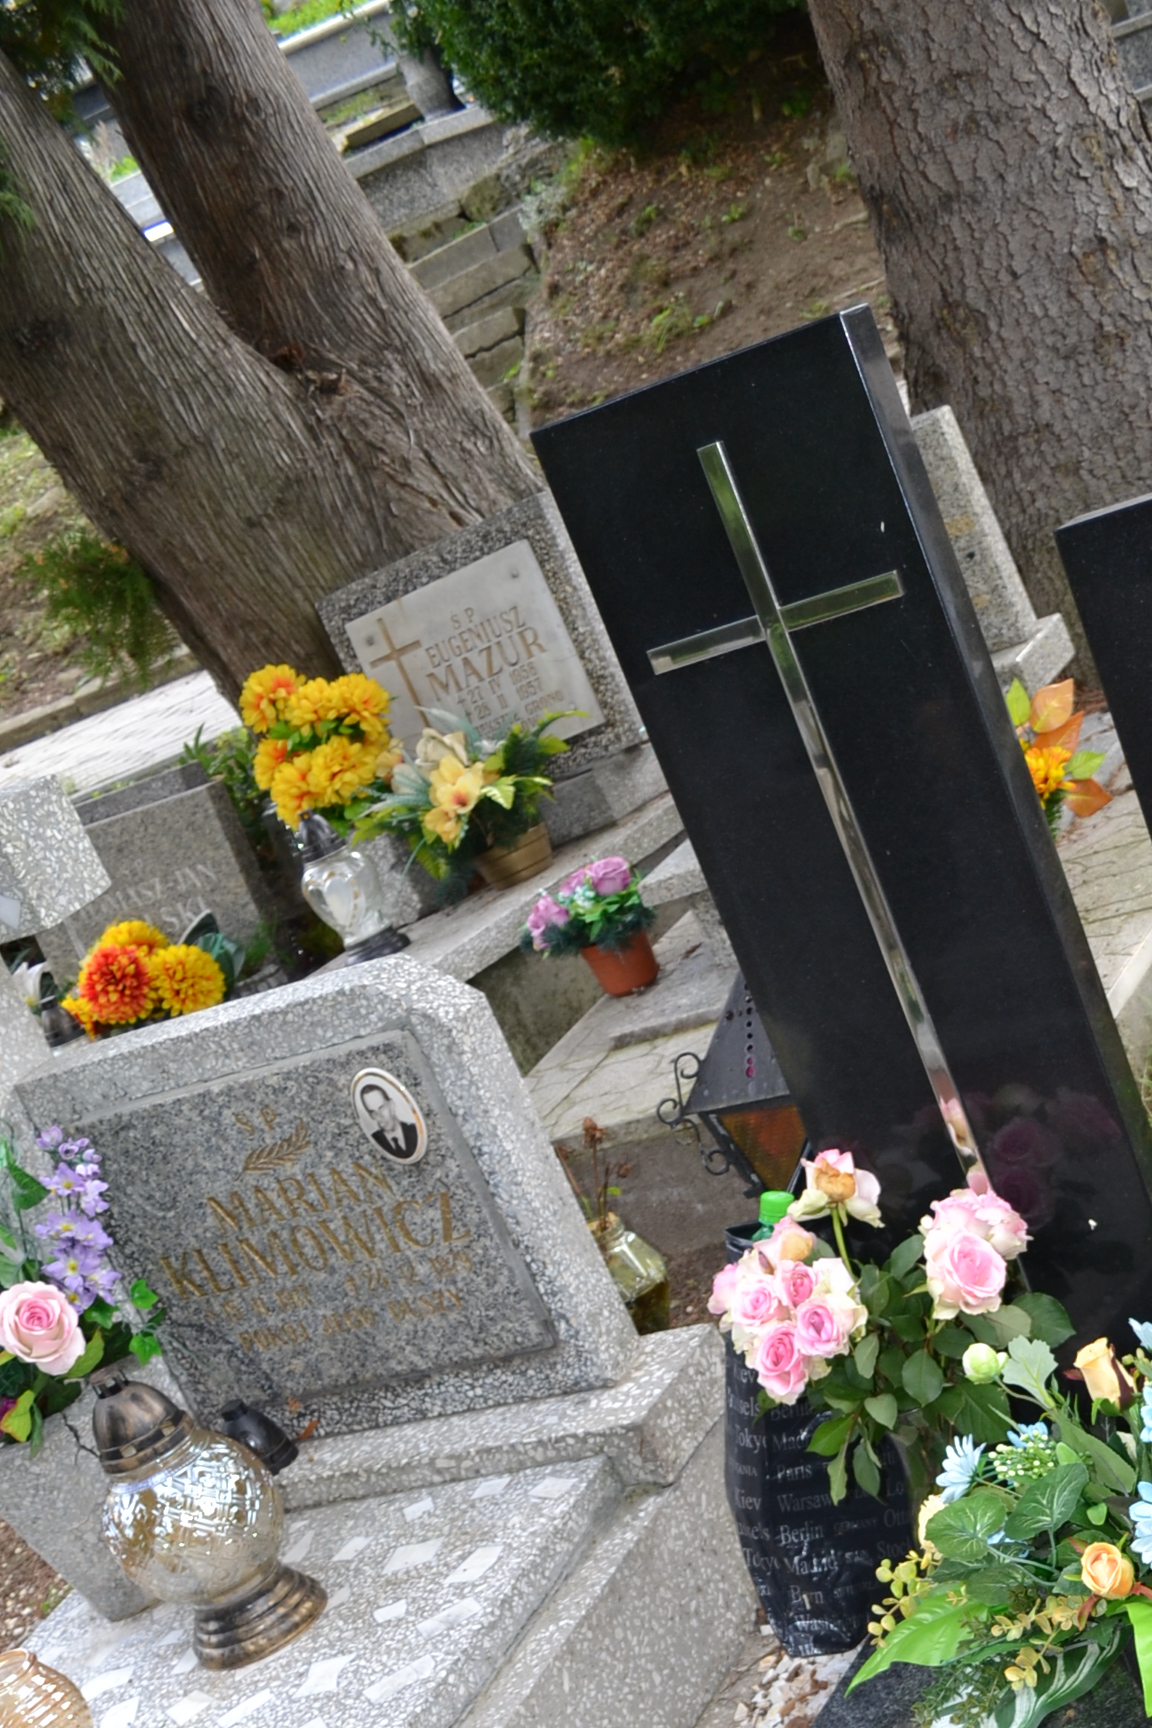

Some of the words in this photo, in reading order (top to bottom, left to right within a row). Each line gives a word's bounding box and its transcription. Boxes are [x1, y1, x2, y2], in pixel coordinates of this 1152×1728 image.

[425, 606, 526, 668] EUGENIUSZ
[426, 626, 547, 702] MAZUR
[206, 1155, 395, 1235] MARIAN
[159, 1191, 472, 1300] KLIMOWICZ
[779, 1521, 825, 1545] Berlin
